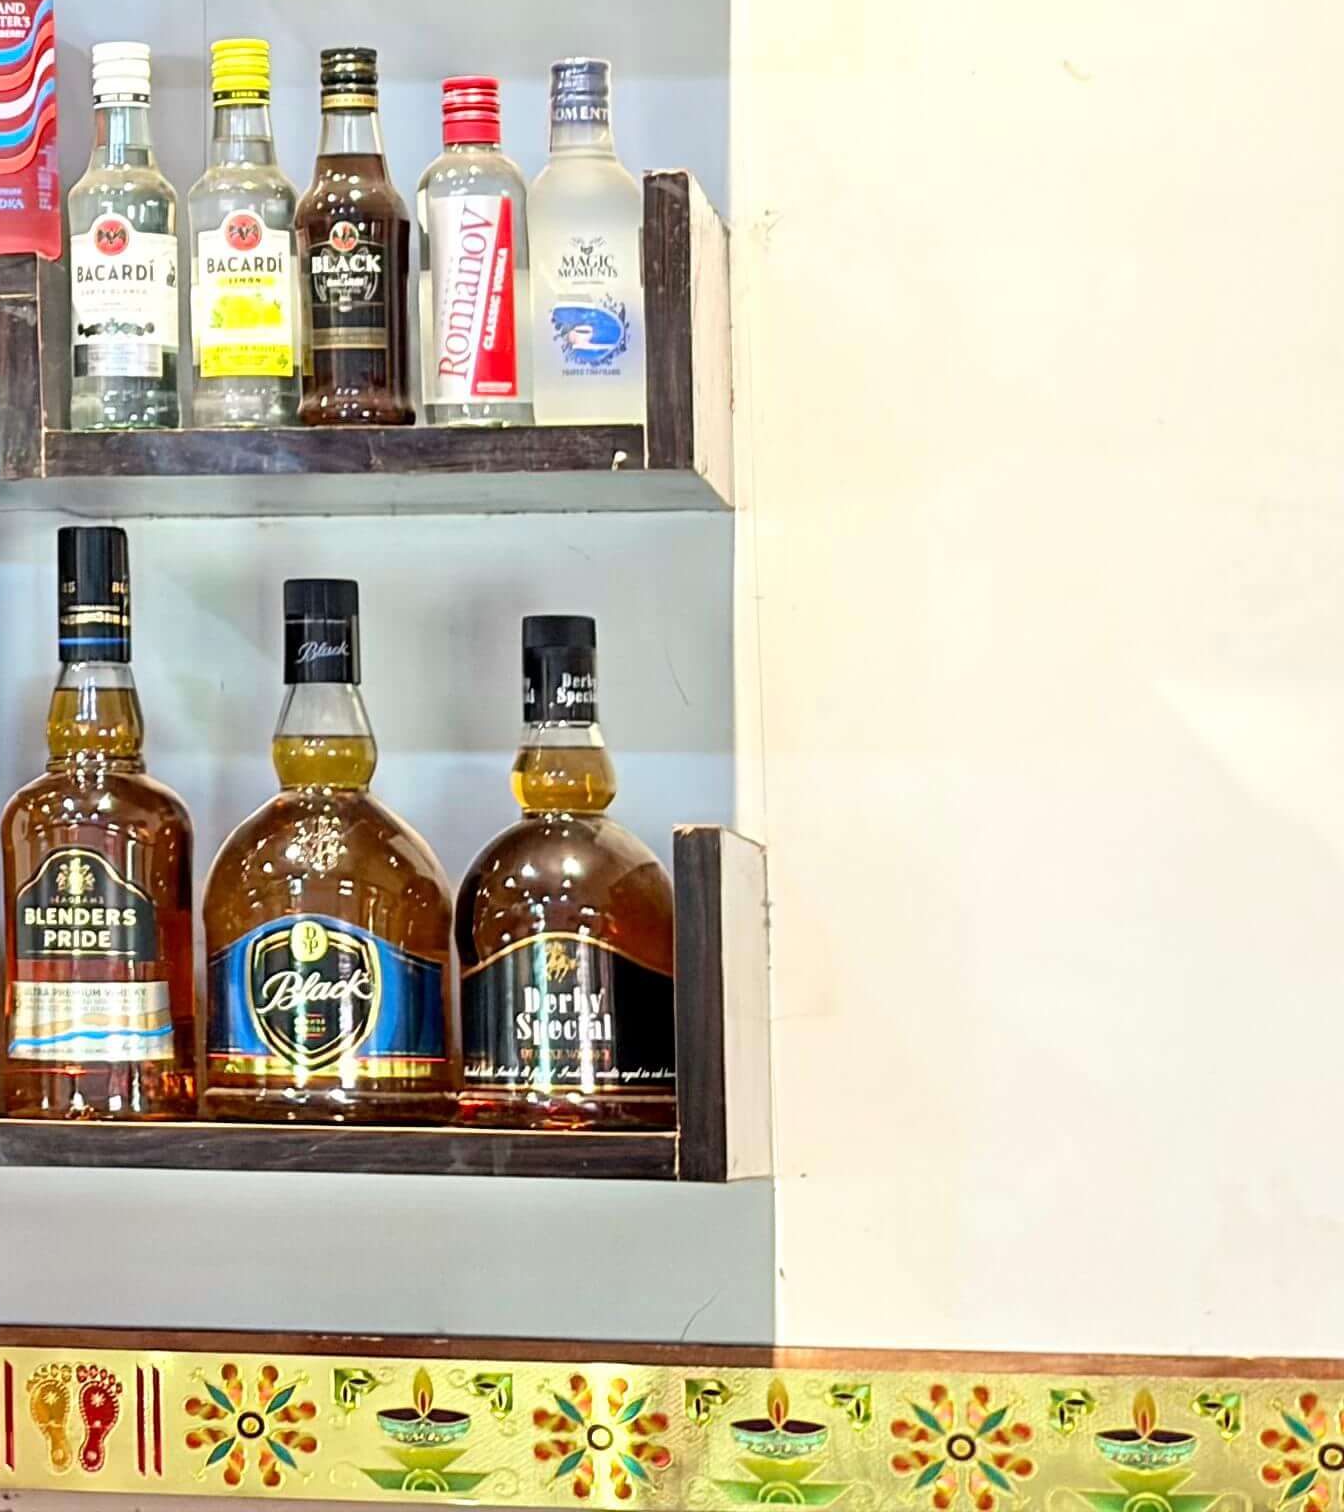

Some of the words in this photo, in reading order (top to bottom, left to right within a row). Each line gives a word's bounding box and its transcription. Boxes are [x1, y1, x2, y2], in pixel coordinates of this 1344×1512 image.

[76, 259, 155, 284] BACARDÍ
[207, 252, 283, 274] BACARDÍ
[311, 254, 382, 275] BLACK
[557, 265, 618, 279] MOMENTS
[561, 253, 614, 268] MAGIC
[438, 207, 493, 379] Romanov
[483, 291, 501, 350] CLASSIC
[296, 640, 350, 664] Black
[24, 907, 137, 927] BLENDERS
[43, 929, 112, 949] PRIDE
[256, 969, 374, 1014] Black
[524, 987, 605, 1014] Derby
[516, 1013, 612, 1045] Special
